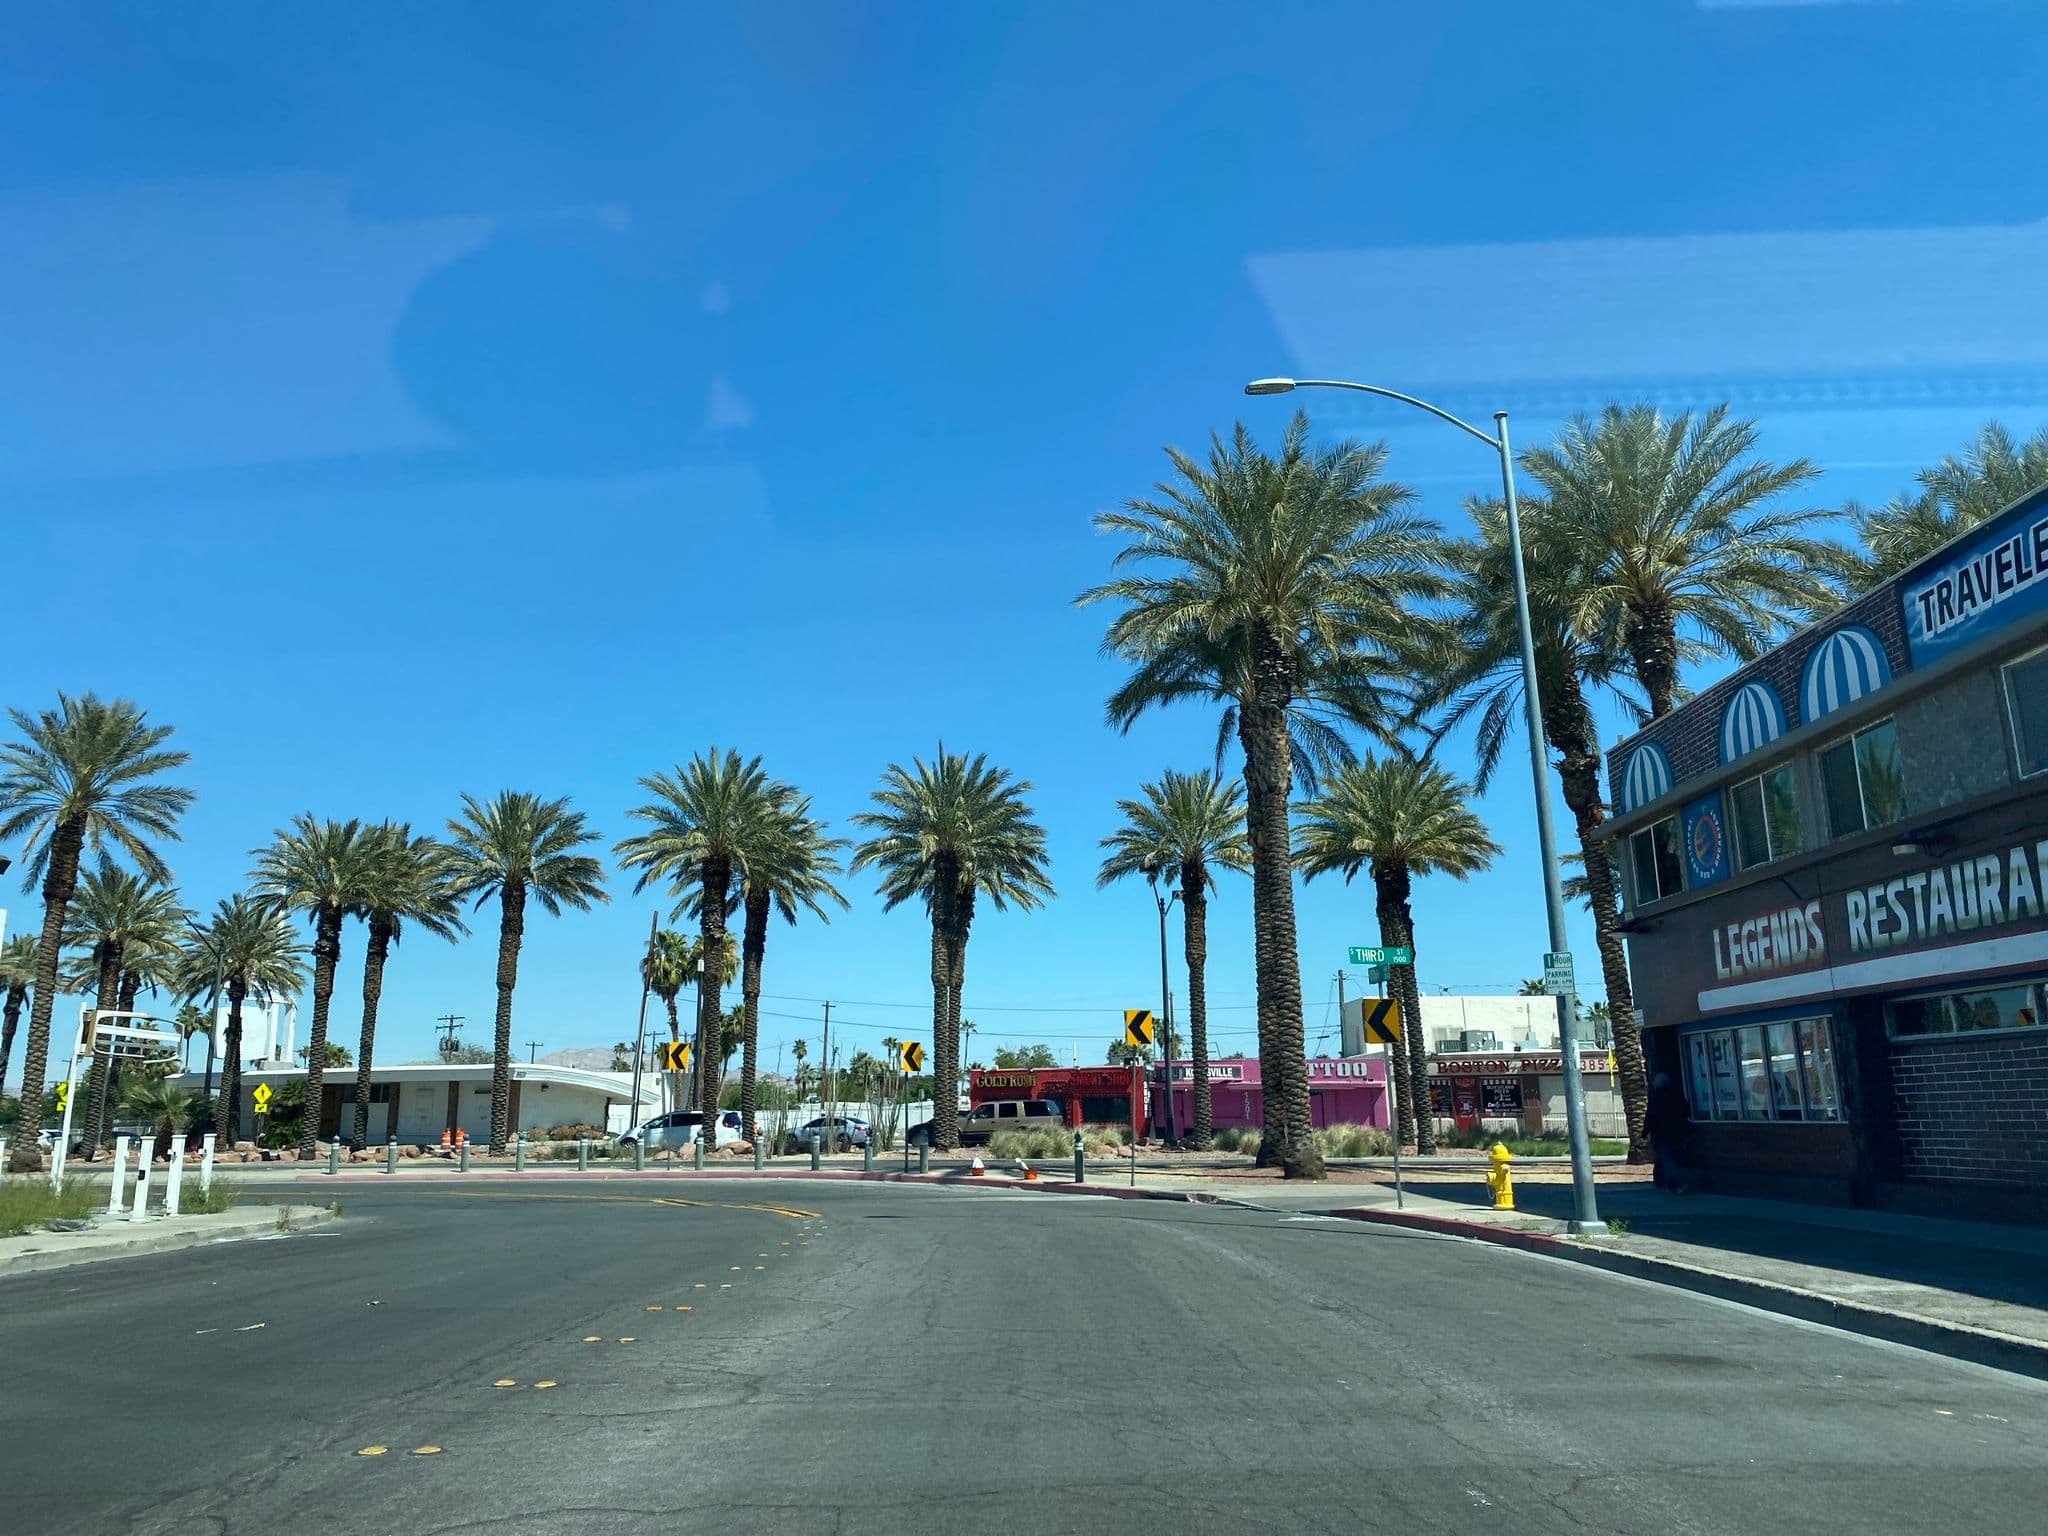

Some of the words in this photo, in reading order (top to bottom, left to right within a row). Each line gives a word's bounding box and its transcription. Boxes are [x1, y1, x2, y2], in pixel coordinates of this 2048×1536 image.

[1713, 902, 1825, 981] LEGENDS
[1355, 949, 1385, 962] THIRD
[1554, 956, 1571, 965] HOUR
[1547, 970, 1572, 978] PARKING
[1306, 1062, 1367, 1077] TTOO
[1436, 1061, 1509, 1074] BOSTON
[1520, 1059, 1562, 1072] PIZZ
[976, 1075, 1007, 1088] GOLD
